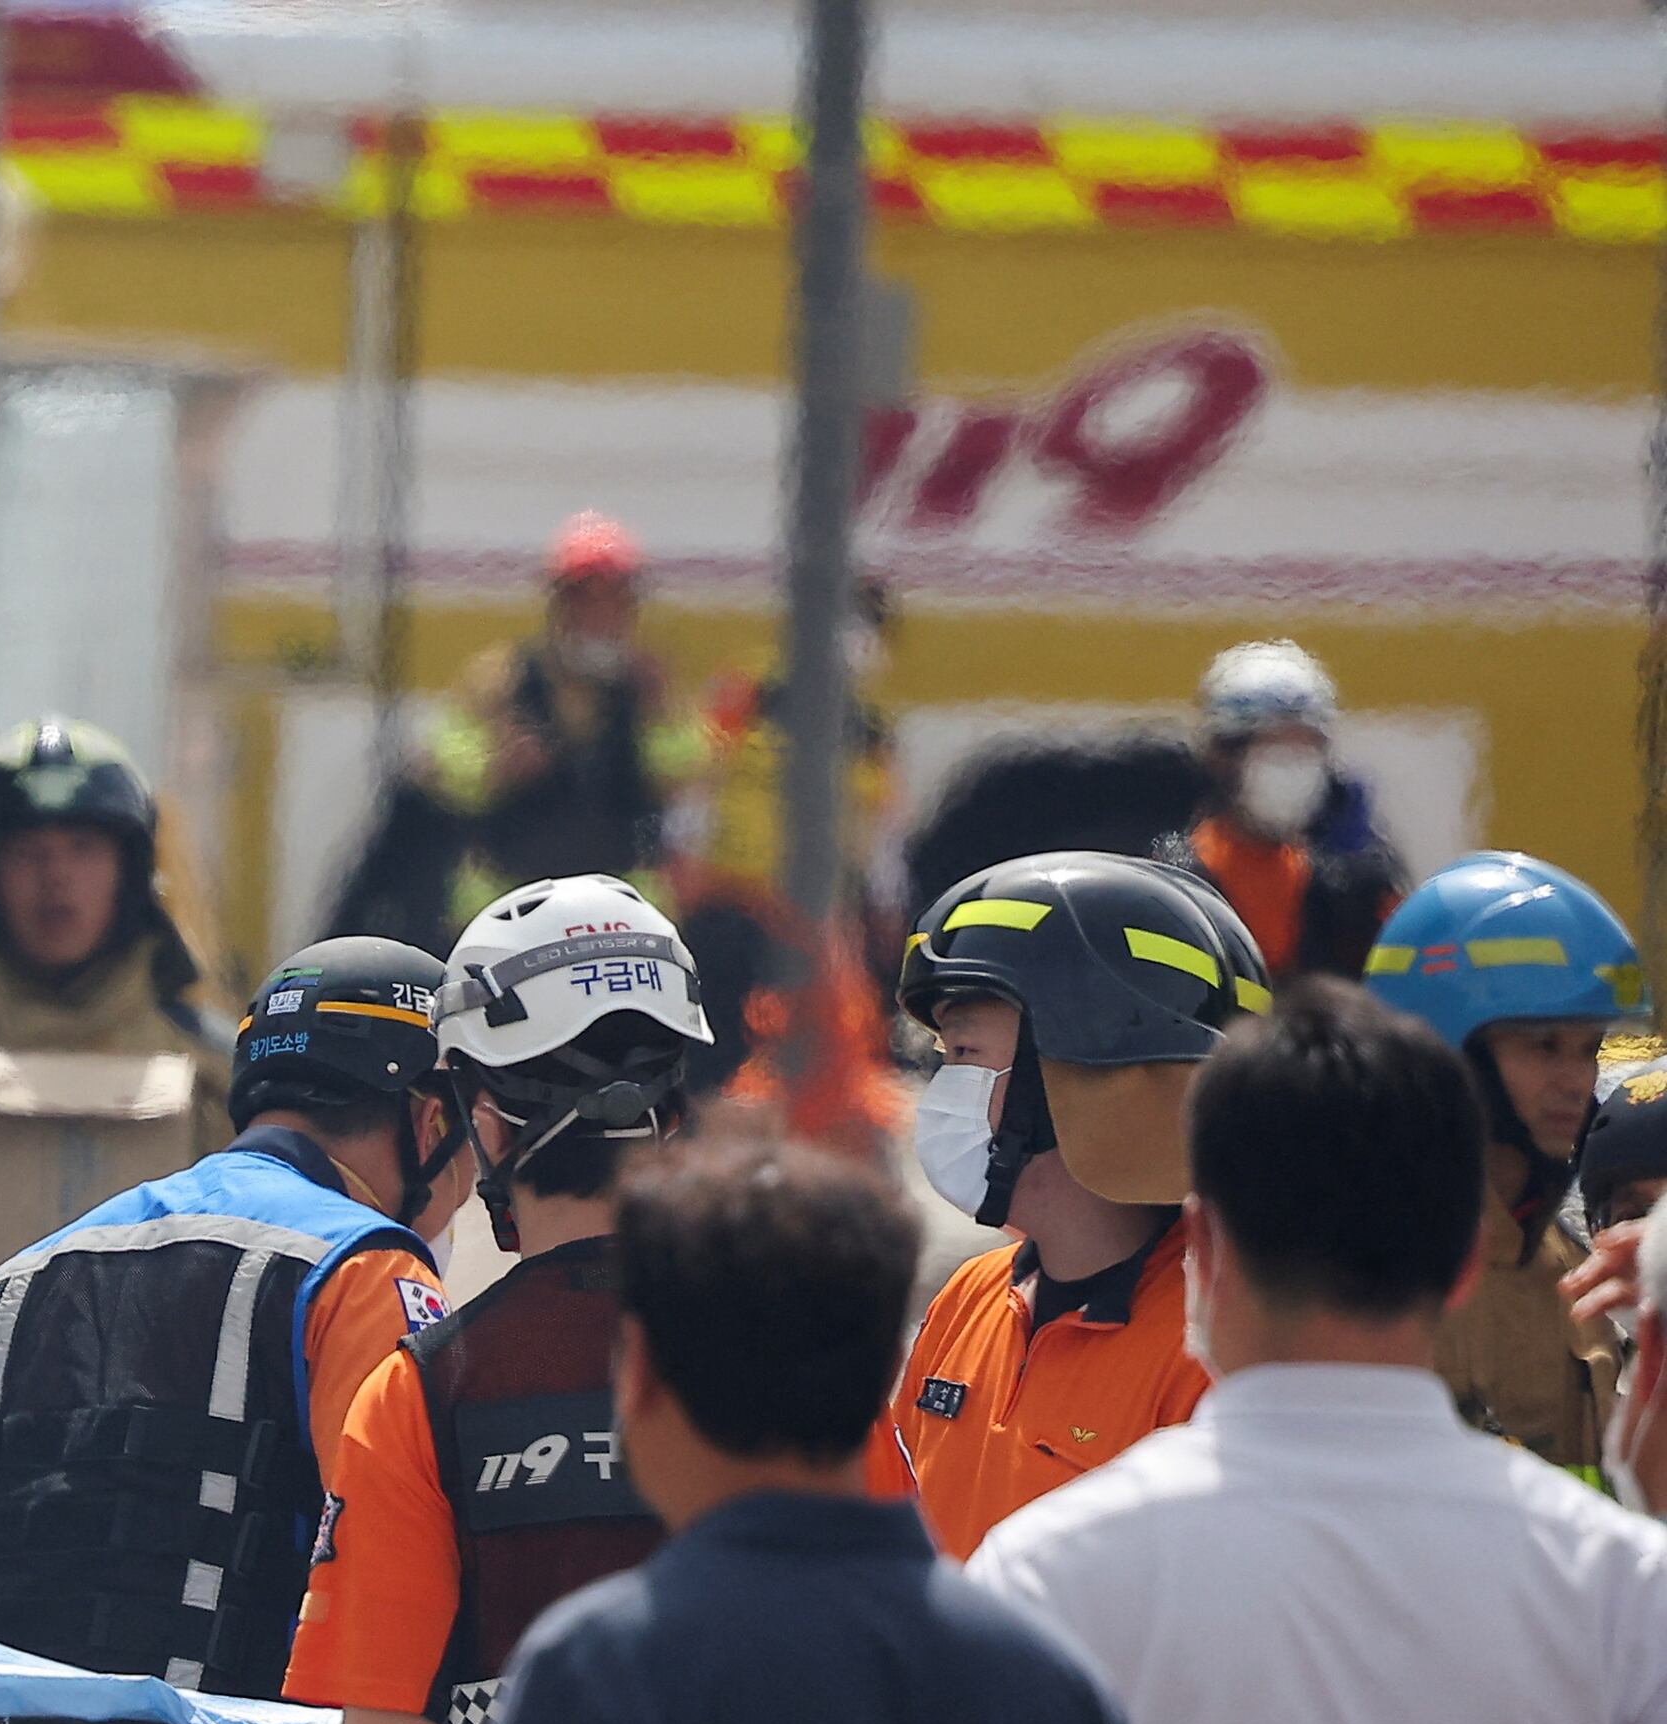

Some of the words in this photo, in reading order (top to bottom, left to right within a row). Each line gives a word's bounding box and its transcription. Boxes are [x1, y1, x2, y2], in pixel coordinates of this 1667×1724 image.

[570, 960, 663, 996] 구급대
[250, 1032, 309, 1061] 경기도소방
[475, 1434, 570, 1492] 119
